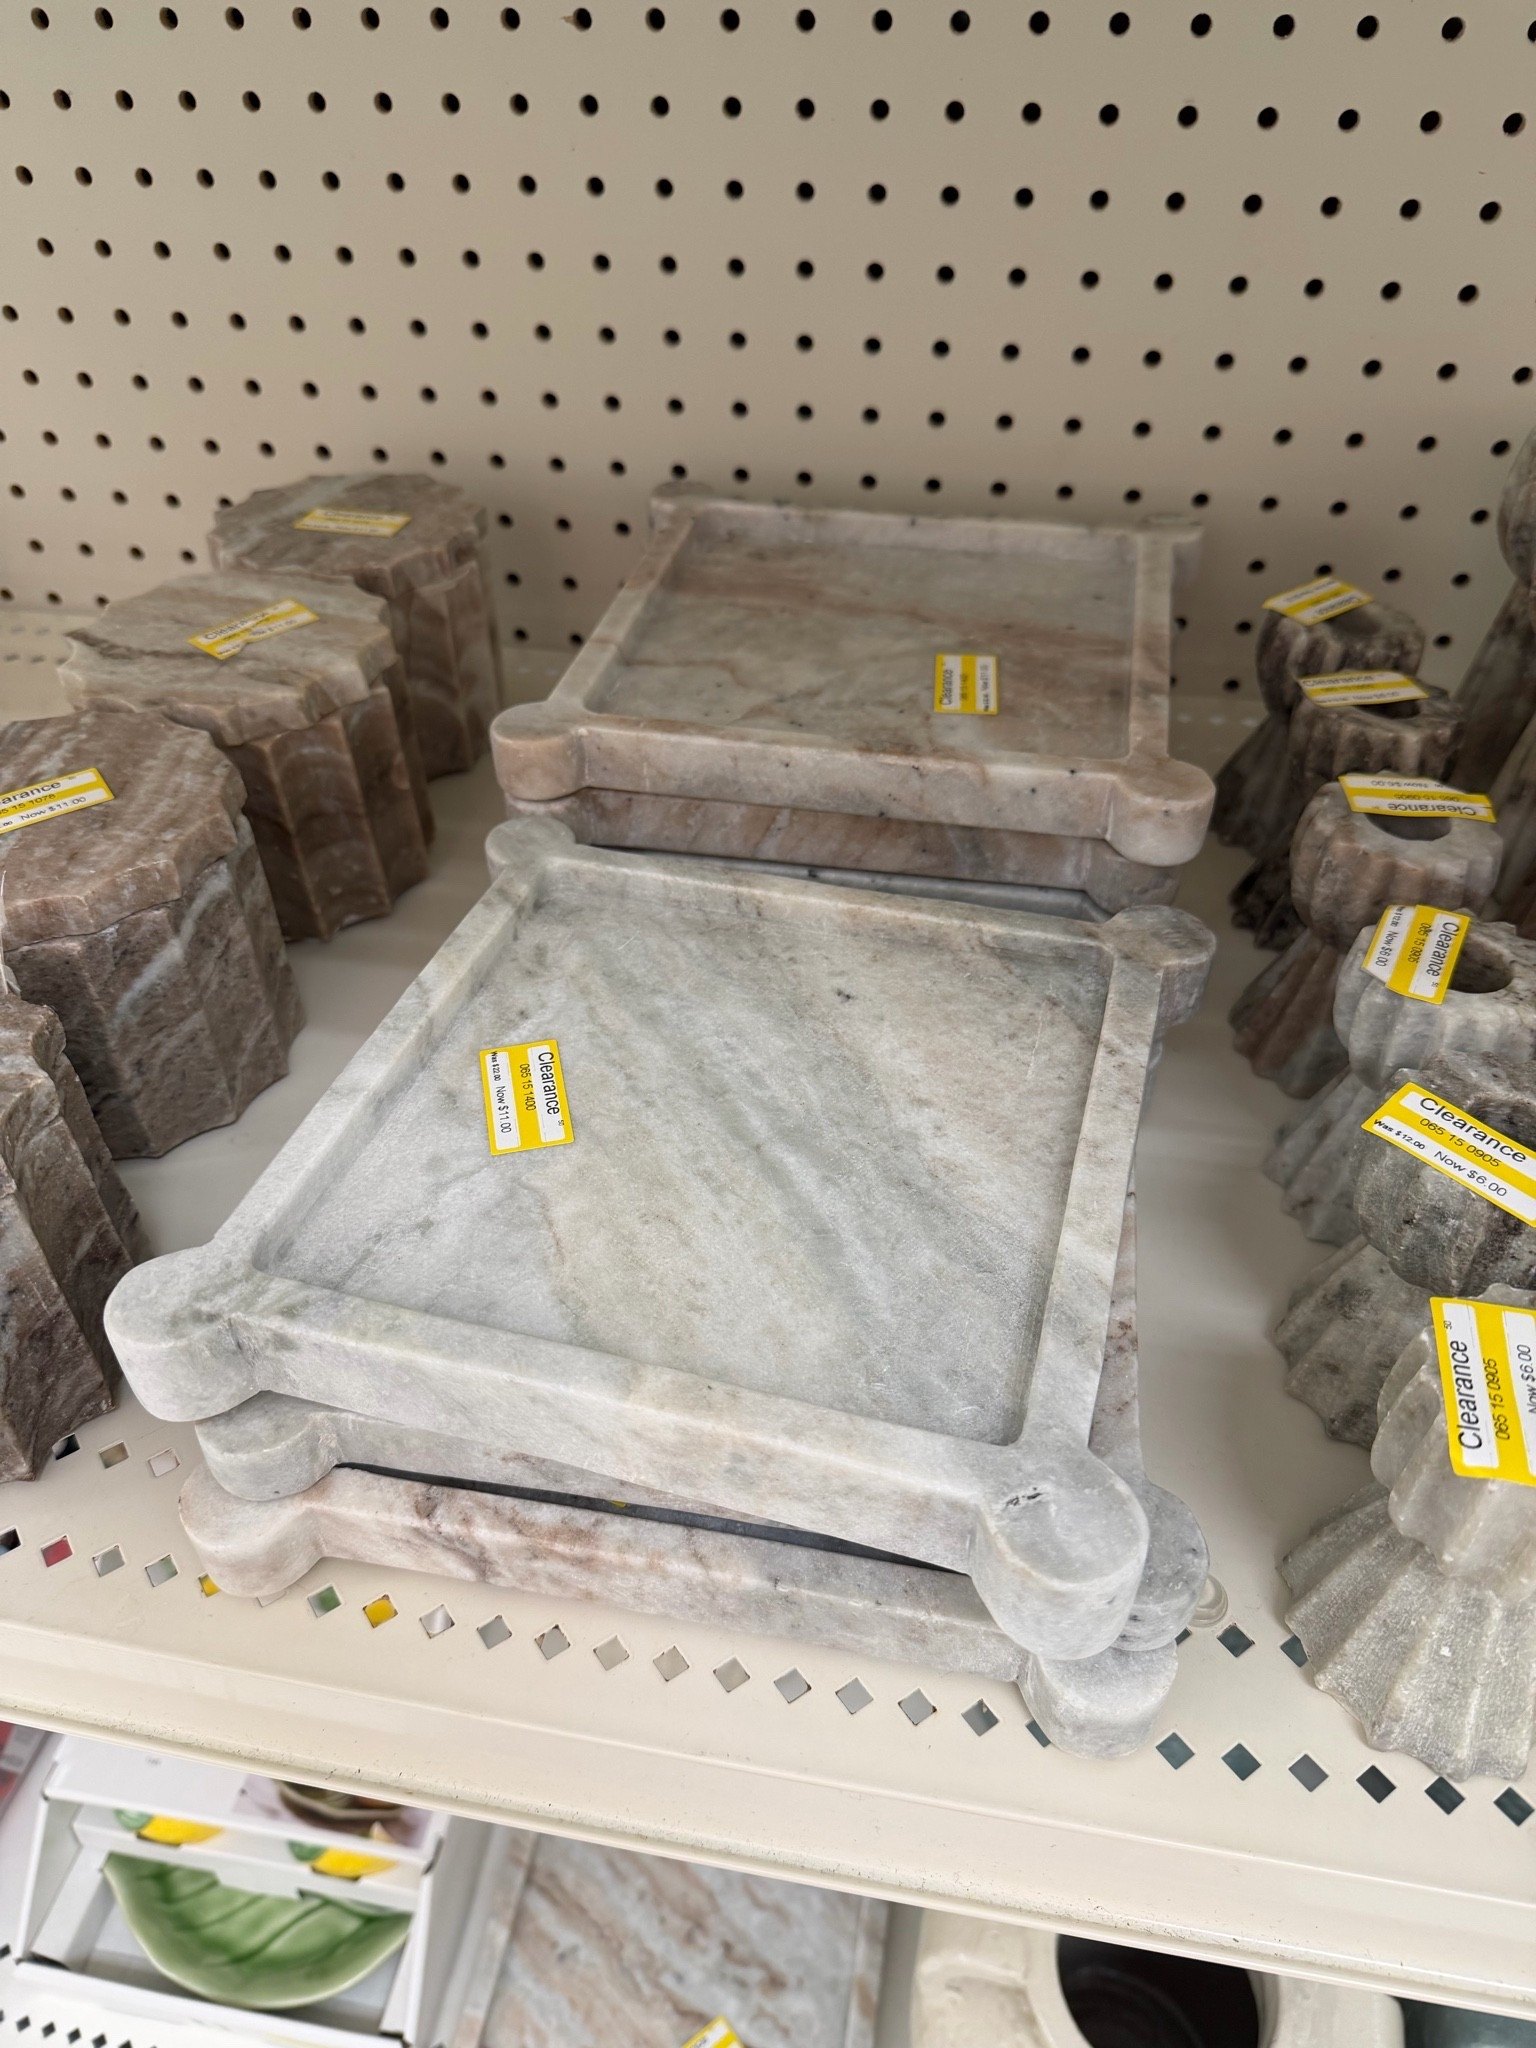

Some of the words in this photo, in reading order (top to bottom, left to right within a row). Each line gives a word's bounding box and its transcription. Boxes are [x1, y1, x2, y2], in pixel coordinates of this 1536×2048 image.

[0, 782, 62, 805] arance
[20, 809, 47, 821] Now
[48, 796, 87, 812] $11.00
[1387, 802, 1477, 816] Clearance
[1384, 930, 1399, 947] Now
[1413, 937, 1425, 947] 15
[1425, 921, 1460, 977] Clearance
[1375, 946, 1392, 967] $6.00
[519, 1063, 532, 1078] 065
[496, 1085, 507, 1105] Now
[522, 1079, 534, 1090] 15
[538, 1051, 560, 1115] Clearance
[523, 1091, 537, 1111] 1400
[497, 1105, 512, 1134] $11.00
[1419, 1096, 1527, 1164] Clearance
[1419, 1117, 1447, 1136] 065
[1448, 1133, 1466, 1147] 15
[1466, 1144, 1502, 1168] 0905
[1373, 1118, 1394, 1133] Was
[1394, 1129, 1426, 1150] $12.00
[1433, 1150, 1466, 1173] Now
[1466, 1169, 1508, 1197] $6.00
[1443, 1320, 1453, 1330] 50
[1482, 1357, 1502, 1391] 0905
[1516, 1344, 1536, 1383] $6.00
[1456, 1339, 1483, 1450] Clearance
[1489, 1391, 1504, 1409] 15
[1492, 1413, 1510, 1441] 065
